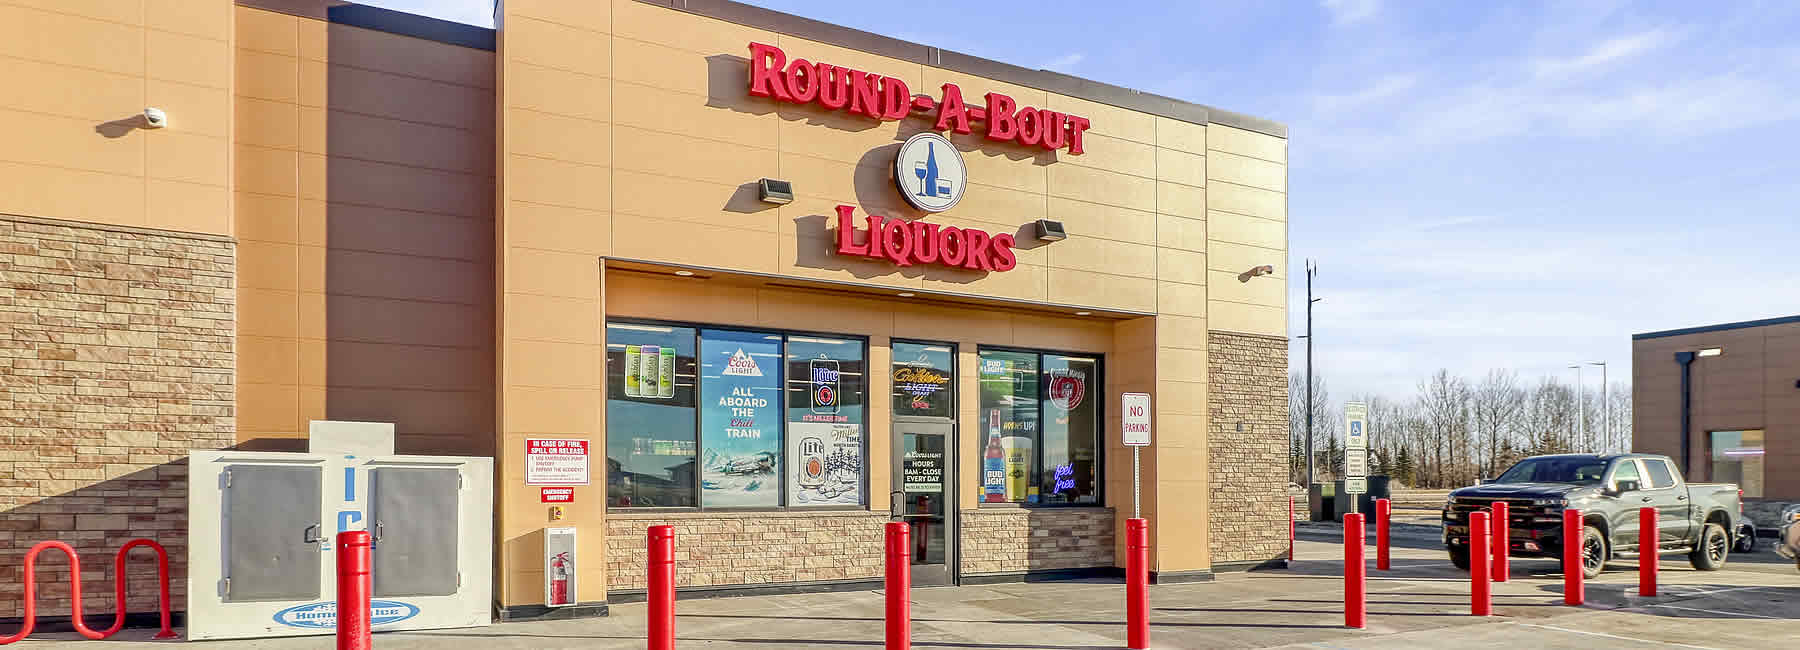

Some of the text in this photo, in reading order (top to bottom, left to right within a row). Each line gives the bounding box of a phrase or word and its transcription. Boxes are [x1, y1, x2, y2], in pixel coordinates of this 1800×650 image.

[835, 205, 1017, 272] LIQUORS
[728, 356, 756, 368] Coors
[733, 387, 754, 397] ALL
[719, 397, 767, 408] ABOARD
[732, 408, 755, 417] THE
[1129, 406, 1144, 417] NO
[726, 428, 760, 439] TRAIN
[1125, 423, 1149, 433] PARKING
[804, 441, 824, 456] Lite
[987, 470, 1003, 478] BUD
[1054, 462, 1074, 481] feel
[985, 477, 1004, 485] LIGHT
[1053, 477, 1076, 494] free
